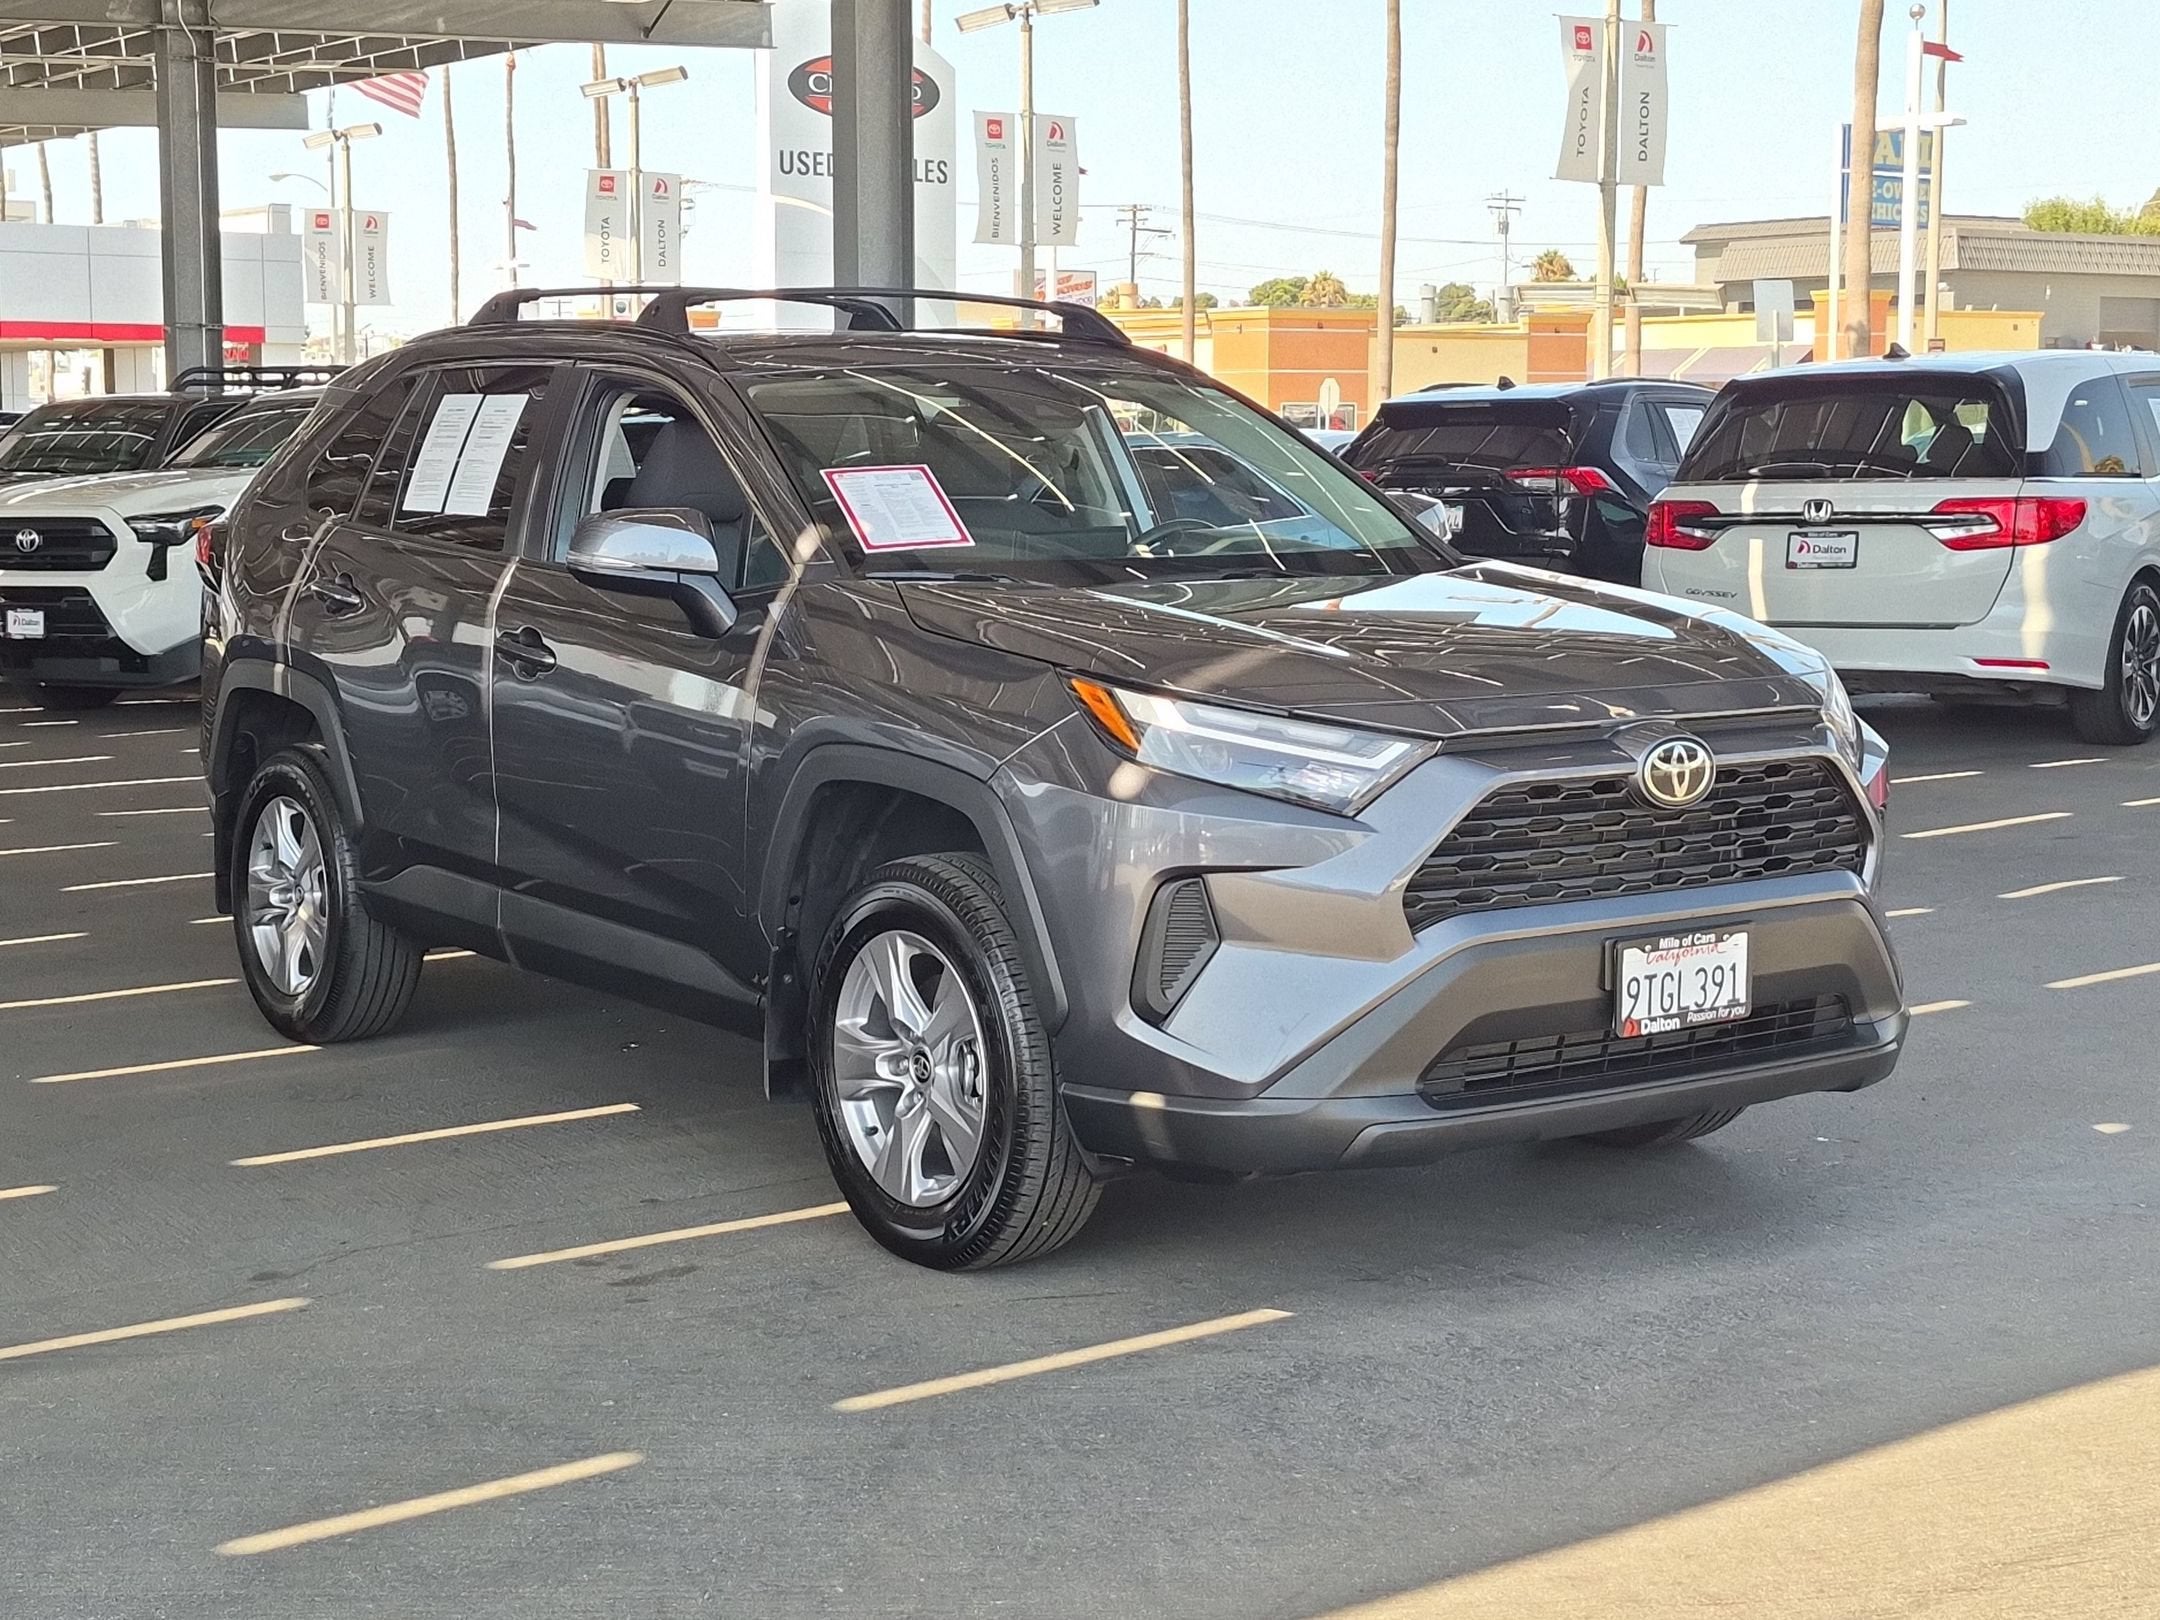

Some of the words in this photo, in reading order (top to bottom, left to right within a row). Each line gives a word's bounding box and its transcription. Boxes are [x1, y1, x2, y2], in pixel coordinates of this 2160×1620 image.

[1576, 87, 1590, 157] TOYOTA
[1638, 92, 1651, 162] DALTON
[913, 158, 948, 184] LES
[991, 157, 1000, 238] BIENVENIDOS
[1052, 162, 1063, 235] WELCOME
[601, 216, 610, 263] TOYOTA
[658, 219, 667, 267] DALTON
[318, 241, 327, 300] BIENVENIDOS
[367, 246, 376, 299] WELCOME
[1813, 544, 1847, 554] Dalton
[1646, 943, 1727, 967] California
[1660, 938, 1680, 950] Mile
[1682, 935, 1692, 947] of
[1694, 933, 1715, 945] Cars
[1626, 962, 1741, 1018] 9TGL391
[1640, 1017, 1680, 1035] Dalton
[1687, 1009, 1716, 1023] Passion
[1718, 1006, 1731, 1018] for
[1731, 1004, 1746, 1019] you
